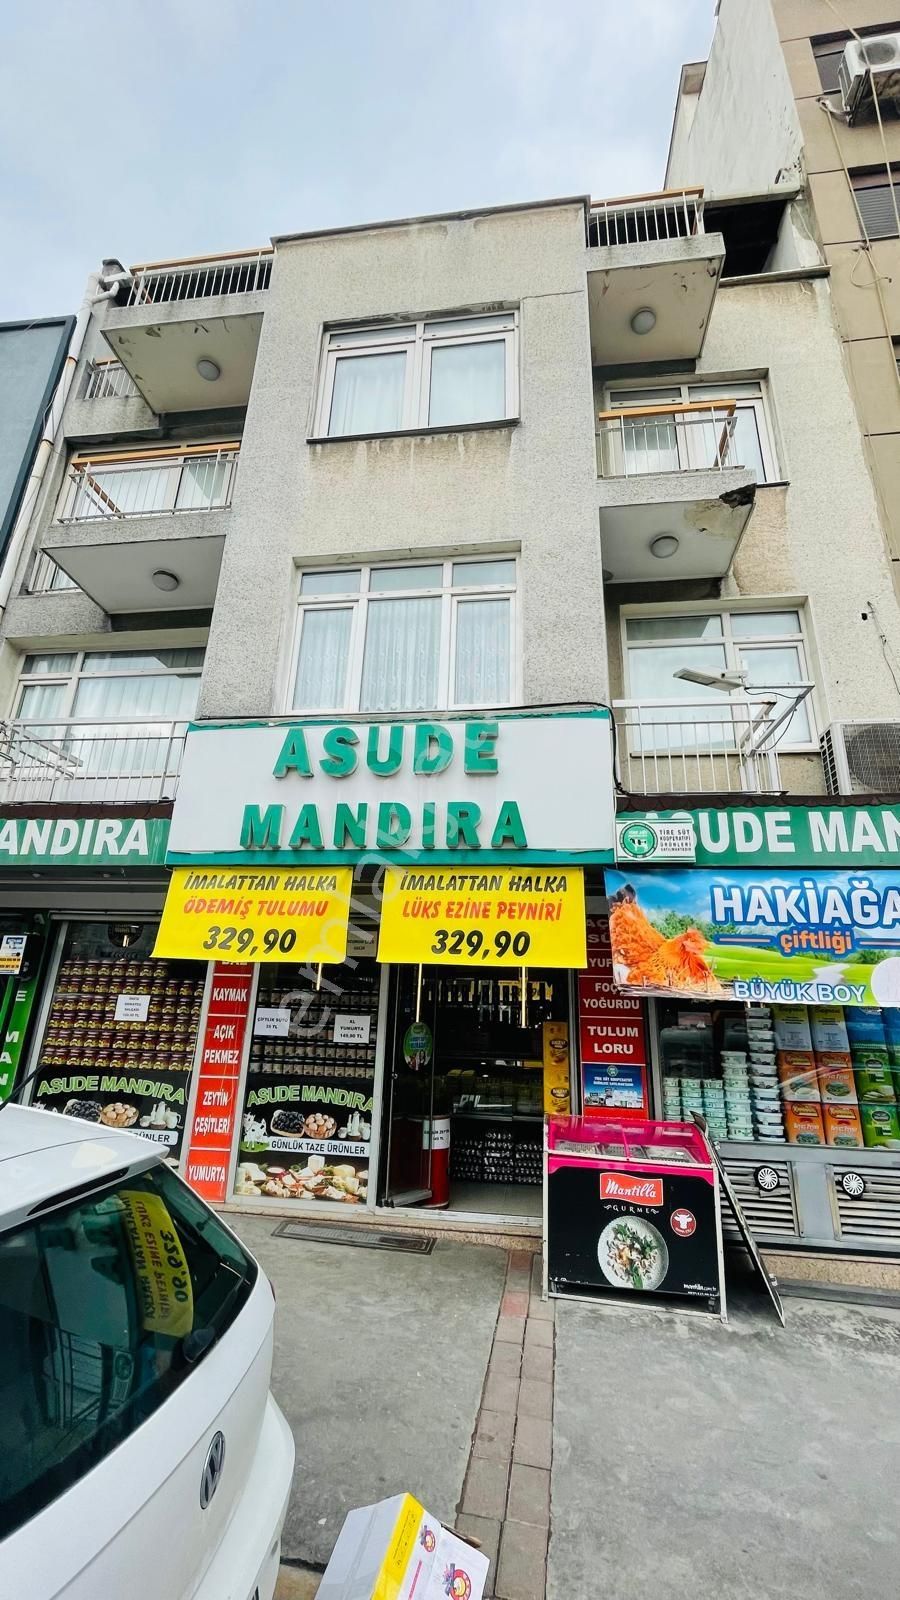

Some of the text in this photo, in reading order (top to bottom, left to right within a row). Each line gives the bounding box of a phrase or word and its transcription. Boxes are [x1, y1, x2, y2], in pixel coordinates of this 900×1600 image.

[272, 722, 499, 778] ASUDE
[239, 801, 528, 850] MANDIRA
[644, 811, 796, 853] UDE
[183, 871, 337, 891] İMALATTAN HALKA
[400, 871, 568, 893] İMALATTAN HALKA
[183, 895, 329, 920] ÖDEMİŞ TULUMU
[402, 896, 563, 922] LÜKS EZİNE PEYNİRİ
[202, 925, 297, 956] 329,90
[431, 929, 531, 960] 329,90
[780, 930, 852, 954] çiftliği
[212, 987, 248, 1002] KAYMAK
[595, 982, 618, 995] FOÇ
[734, 980, 866, 1002] BÜYÜK BOY
[583, 997, 640, 1010] YOĞURDU
[213, 1024, 235, 1042] AÇIK
[587, 1026, 639, 1037] TULUM
[204, 1049, 239, 1065] PEKMEZ
[593, 1043, 634, 1054] LORU
[37, 1075, 185, 1105] ASUDE MANDIRA
[202, 1088, 229, 1106] ZEYTİN
[246, 1085, 374, 1114] ASUDE MANDIRA
[194, 1115, 231, 1136] ÇEŞİTLERİ
[271, 1140, 366, 1154] GÜNLÜK TAZE ÜRÜNLER
[188, 1164, 226, 1182] YUMURTA
[605, 1178, 657, 1199] Mantilla
[612, 1204, 650, 1214] GURME
